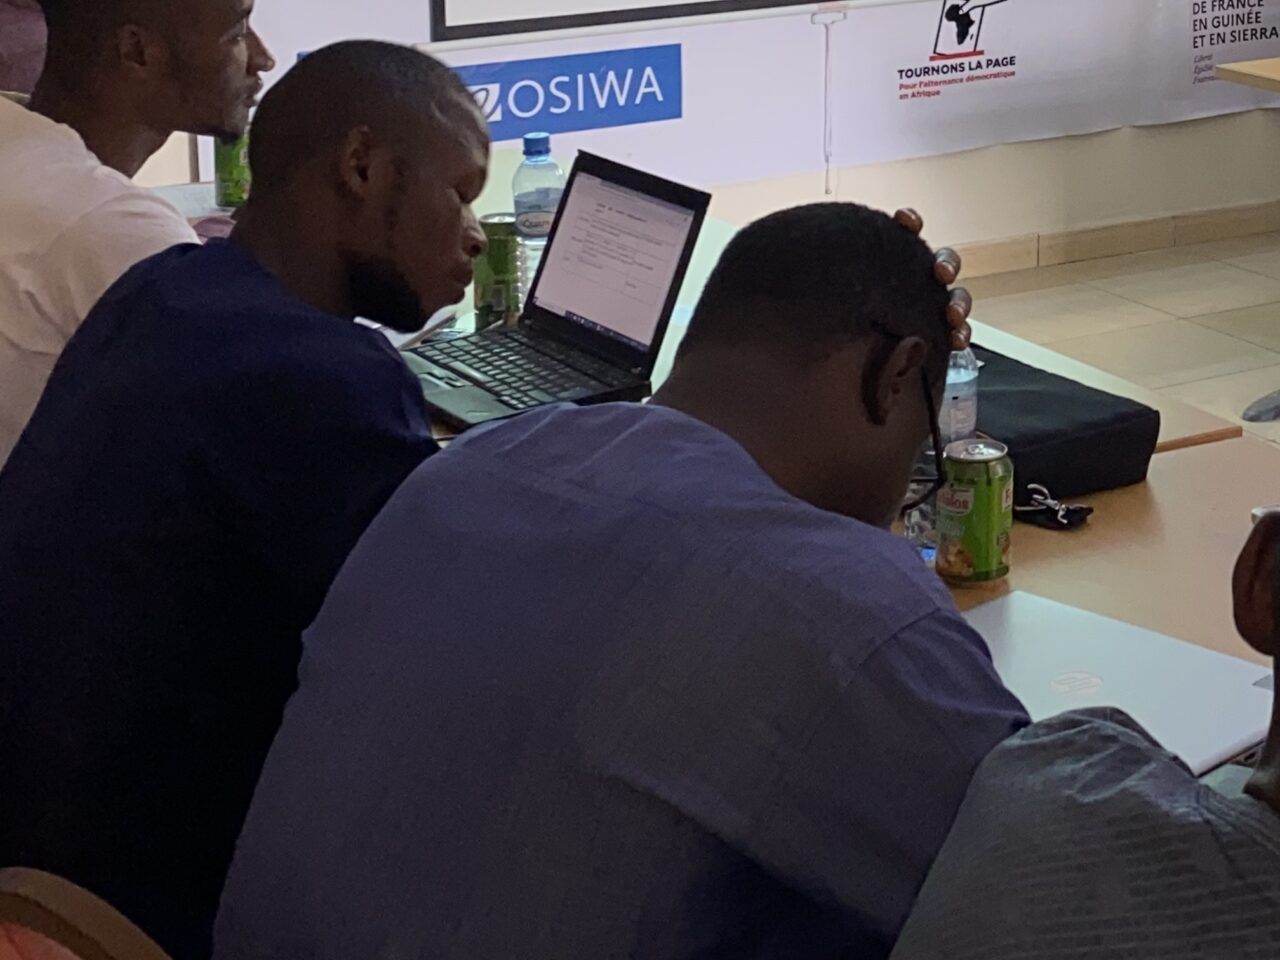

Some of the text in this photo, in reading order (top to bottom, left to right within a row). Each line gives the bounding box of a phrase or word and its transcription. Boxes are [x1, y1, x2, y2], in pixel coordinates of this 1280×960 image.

[1192, 1, 1207, 15] DE
[1193, 9, 1262, 32] EN GUINÉE
[1193, 35, 1205, 49] ET
[1209, 32, 1226, 46] EN
[1230, 26, 1279, 43] SIERRA
[897, 56, 1016, 80] TOURNONS LA PAGE
[508, 66, 664, 118] OSIWA
[911, 89, 941, 99] Afrique
